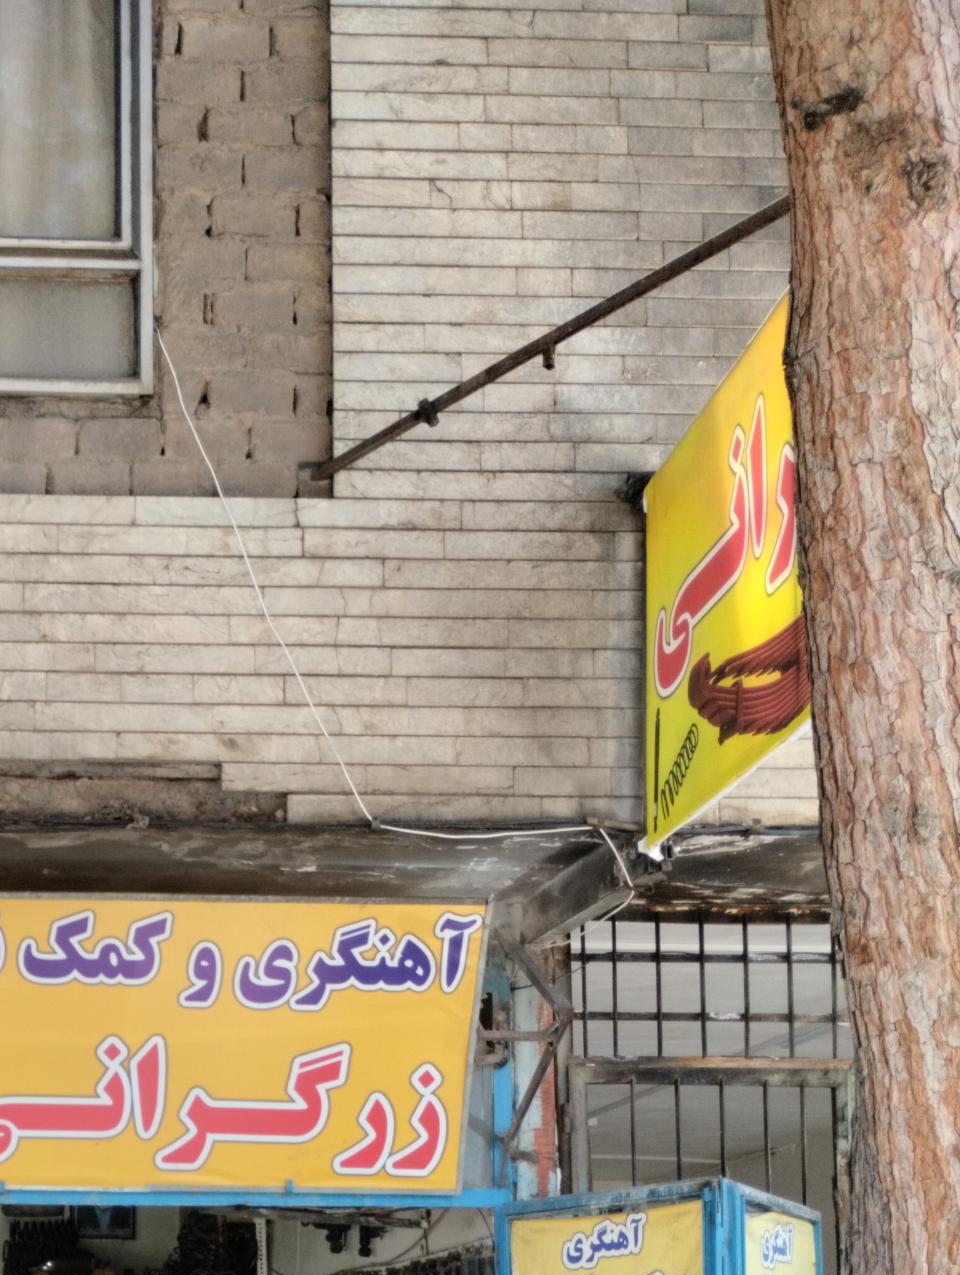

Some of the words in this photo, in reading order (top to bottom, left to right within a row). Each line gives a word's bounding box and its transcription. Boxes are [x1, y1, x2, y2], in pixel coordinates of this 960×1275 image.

[653, 391, 797, 699] رانی
[19, 910, 172, 983] کمک
[180, 941, 221, 1007] و
[236, 913, 481, 1008] آهنگری
[562, 1213, 646, 1268] آهنگری
